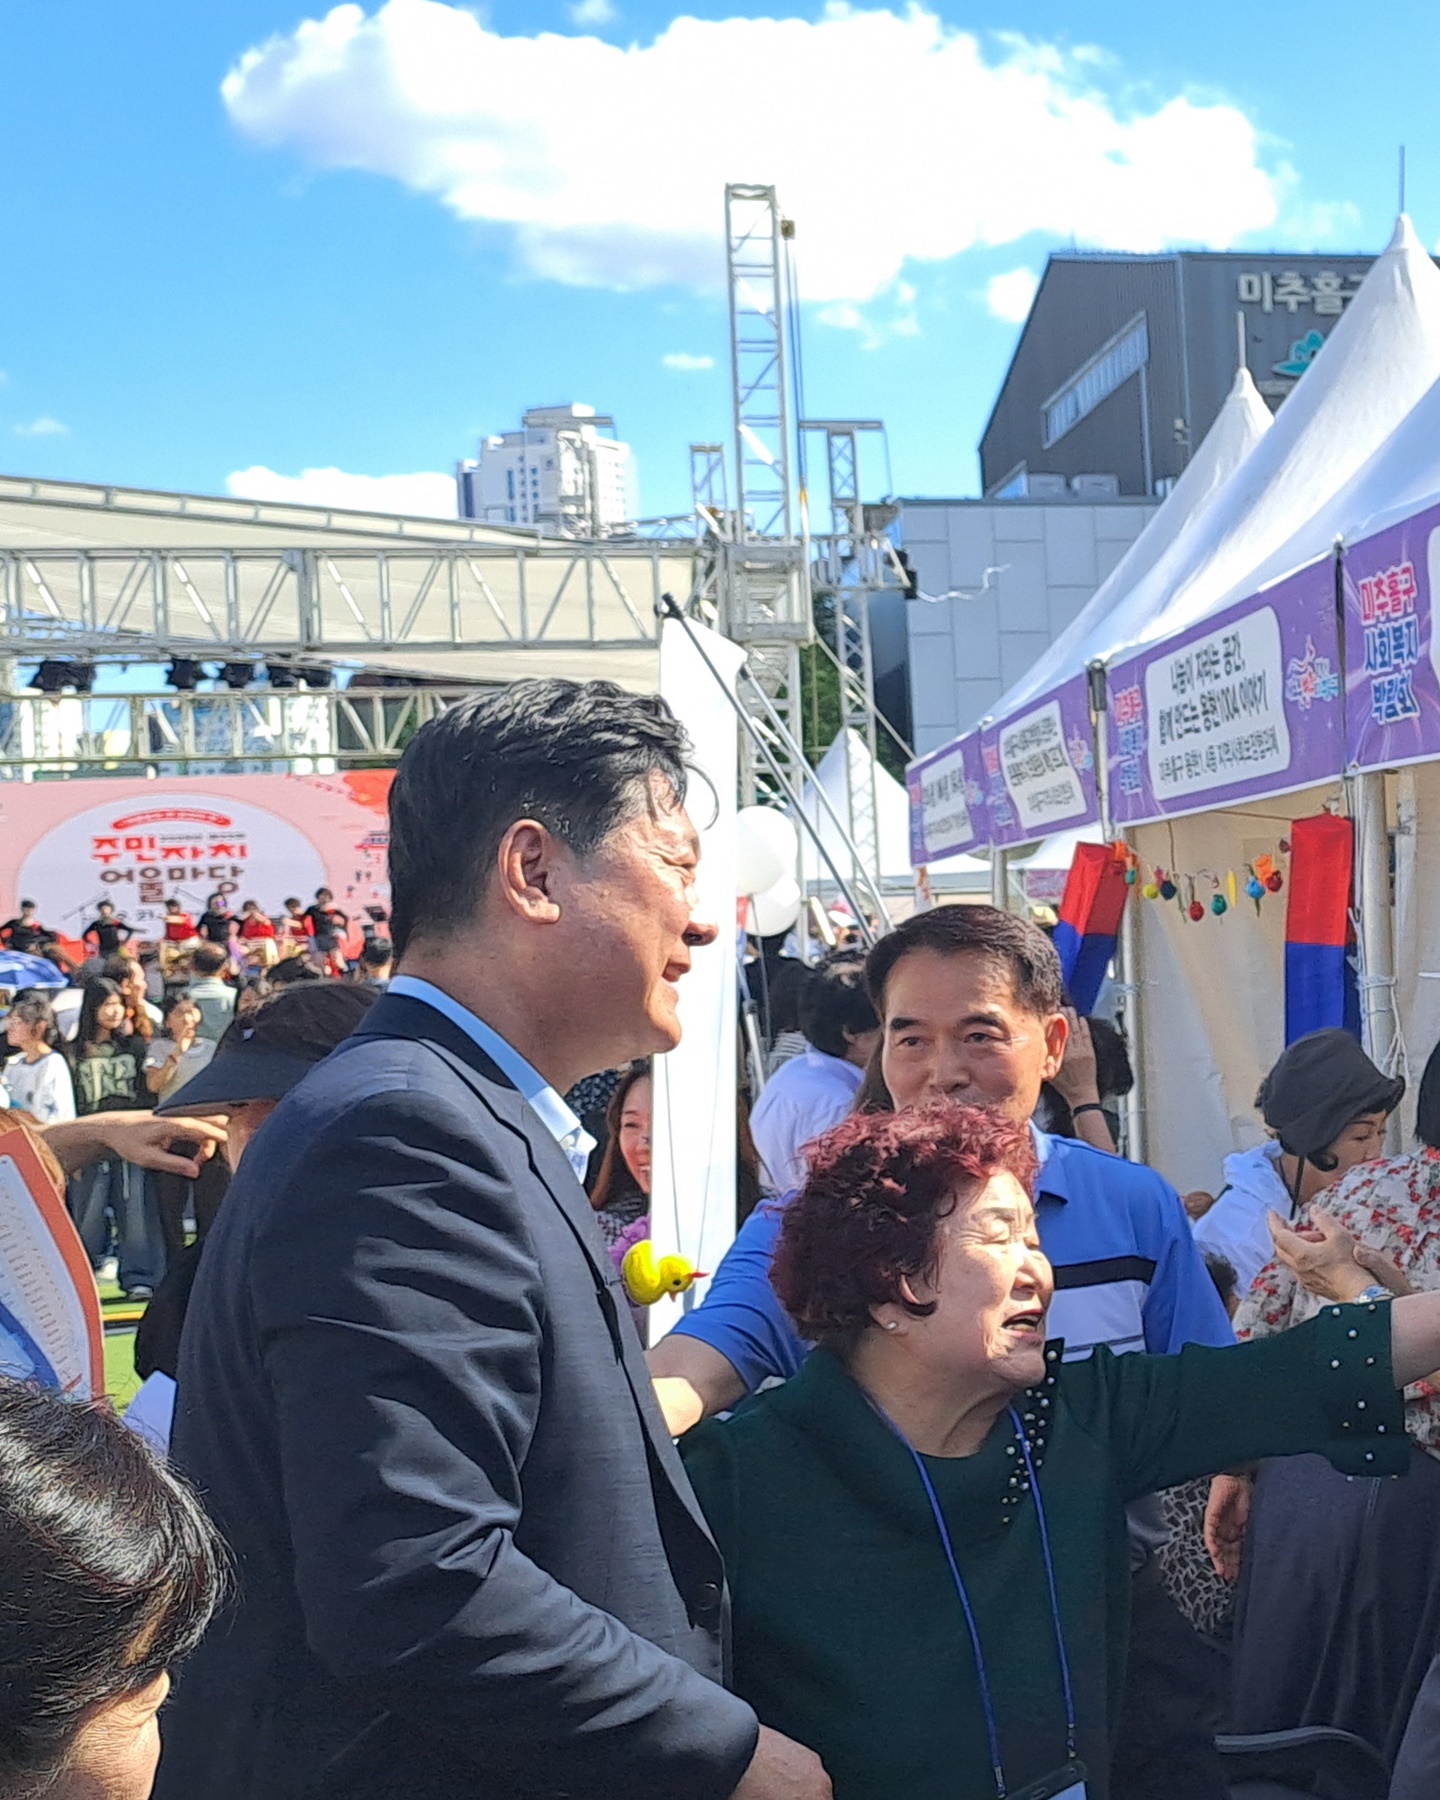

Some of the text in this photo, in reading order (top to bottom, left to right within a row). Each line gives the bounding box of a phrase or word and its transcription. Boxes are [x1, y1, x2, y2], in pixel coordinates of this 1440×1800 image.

[1361, 566, 1415, 621] 미추홀구
[1365, 616, 1418, 671] 사회복지
[1373, 672, 1418, 721] 박람회
[92, 836, 247, 864] 주민자치
[100, 865, 245, 903] 어울마당
